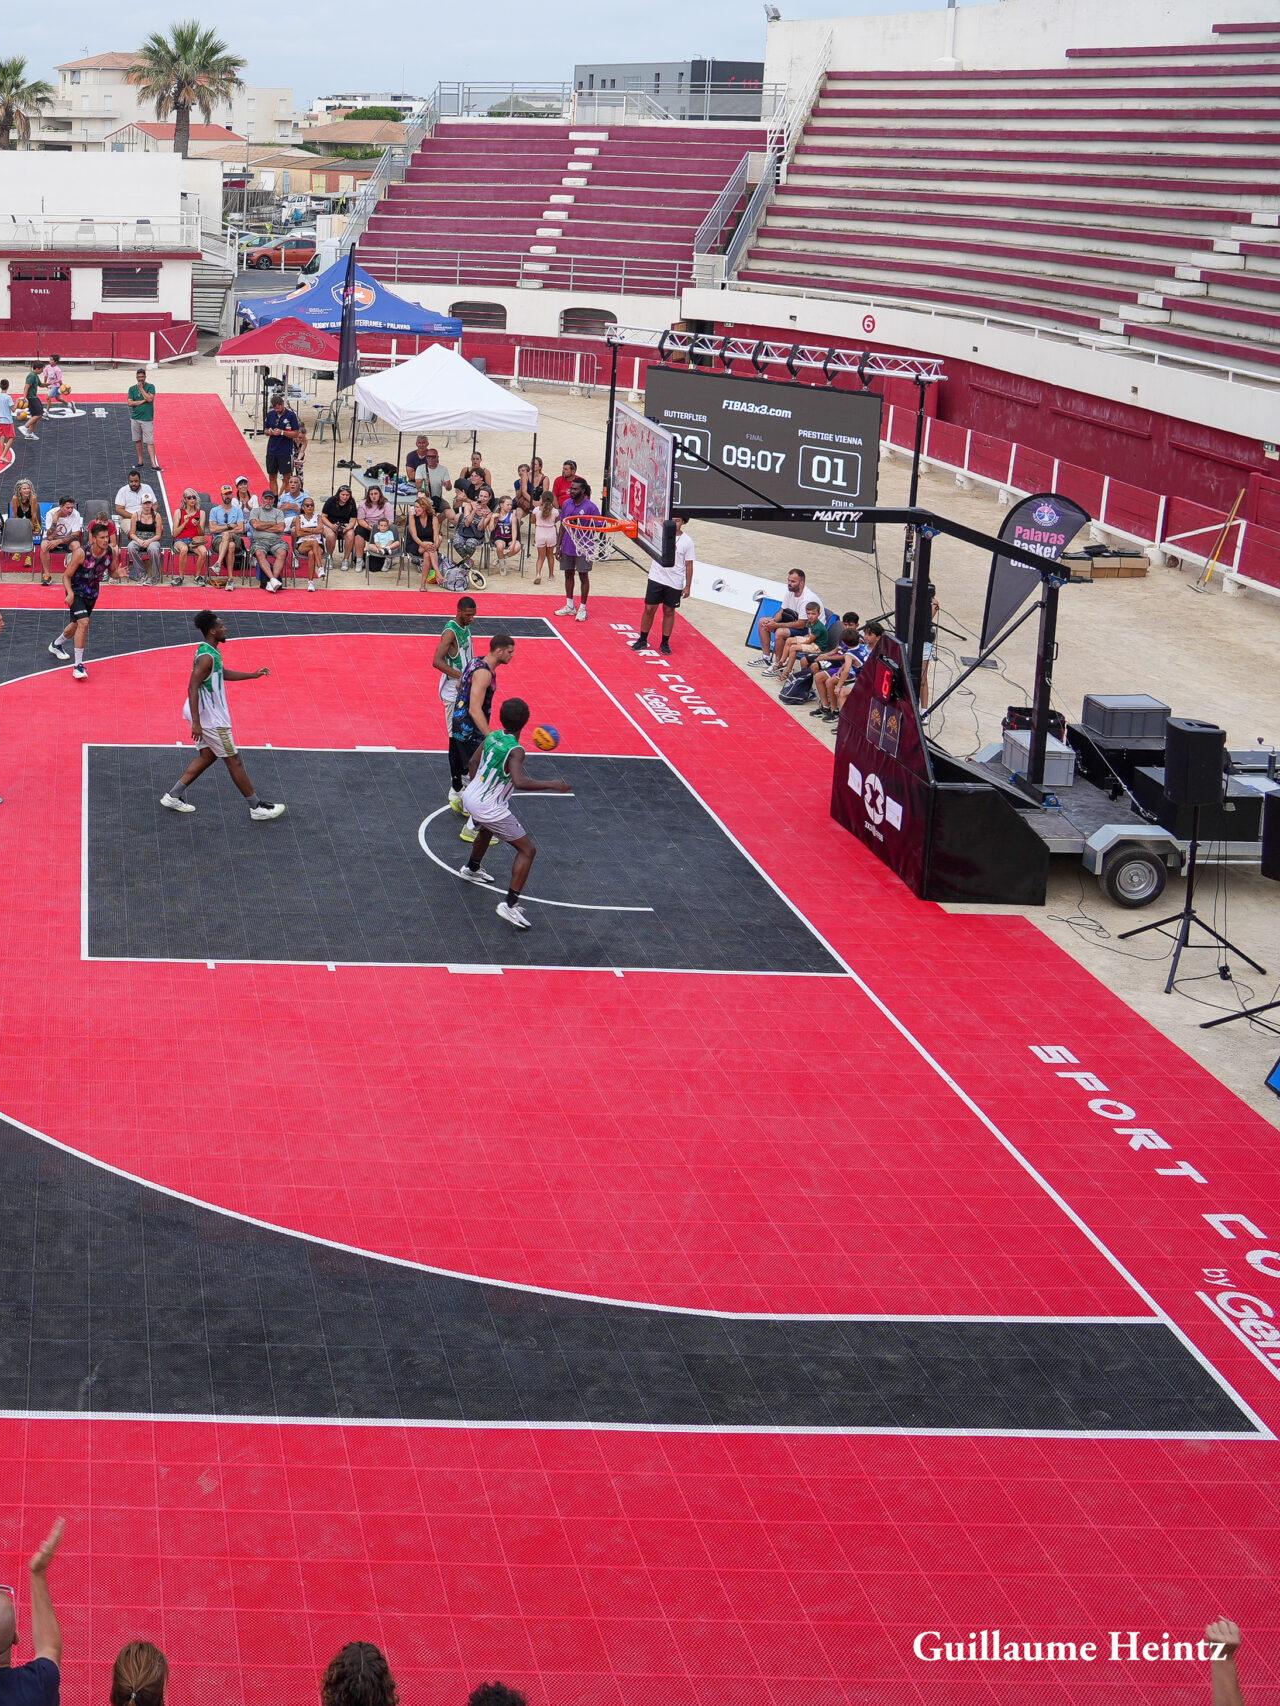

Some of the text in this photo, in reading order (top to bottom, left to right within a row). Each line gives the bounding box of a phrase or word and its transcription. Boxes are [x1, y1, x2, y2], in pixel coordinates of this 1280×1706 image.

[664, 409, 707, 422] BUTTERFLIES
[722, 400, 792, 418] FIBA3x3.com
[798, 429, 863, 446] PRESTIGE VIENNA
[722, 444, 786, 474] 09:07
[811, 455, 847, 487] 01
[1014, 525, 1066, 546] Palavas
[657, 673, 729, 728] COURT
[1027, 1044, 1209, 1185] SPORT
[1201, 1268, 1237, 1288] by
